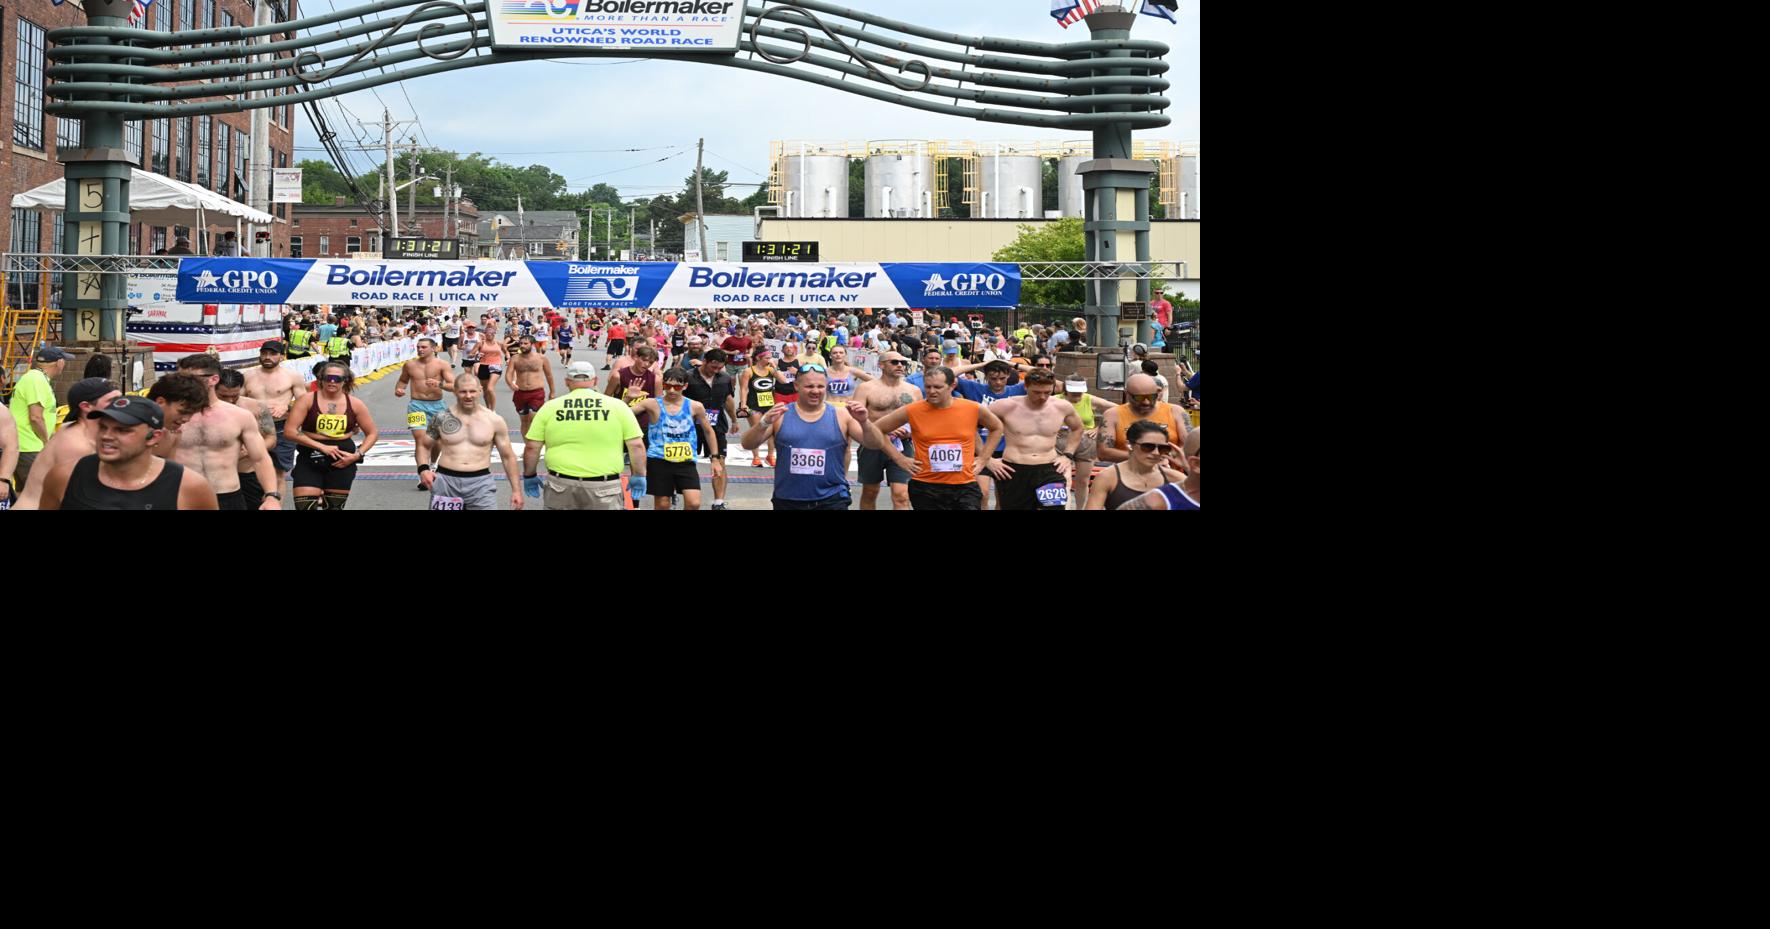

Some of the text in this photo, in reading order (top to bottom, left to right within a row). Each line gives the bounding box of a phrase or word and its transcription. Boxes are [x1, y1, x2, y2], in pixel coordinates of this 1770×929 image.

[585, 0, 733, 15] Boilermaker
[552, 27, 681, 36] UTICA'S WORLD
[519, 36, 616, 44] RENOWNED
[326, 264, 516, 287] Boilermaker
[568, 264, 640, 275] Boilermaker
[222, 269, 278, 289] GPO
[689, 266, 876, 288] Boilermaker
[950, 273, 1005, 291] GPO
[351, 291, 499, 301] ROAD RACE UTICA NY
[713, 294, 859, 302] ROAD RACE UTICA NY
[828, 382, 848, 391] 1777
[563, 398, 603, 409] RACE
[555, 409, 610, 421] SAFETY
[318, 418, 346, 431] 6571
[665, 445, 692, 458] 5778
[930, 449, 962, 462] 4067
[791, 453, 825, 468] 3366
[1038, 487, 1067, 501] 2626
